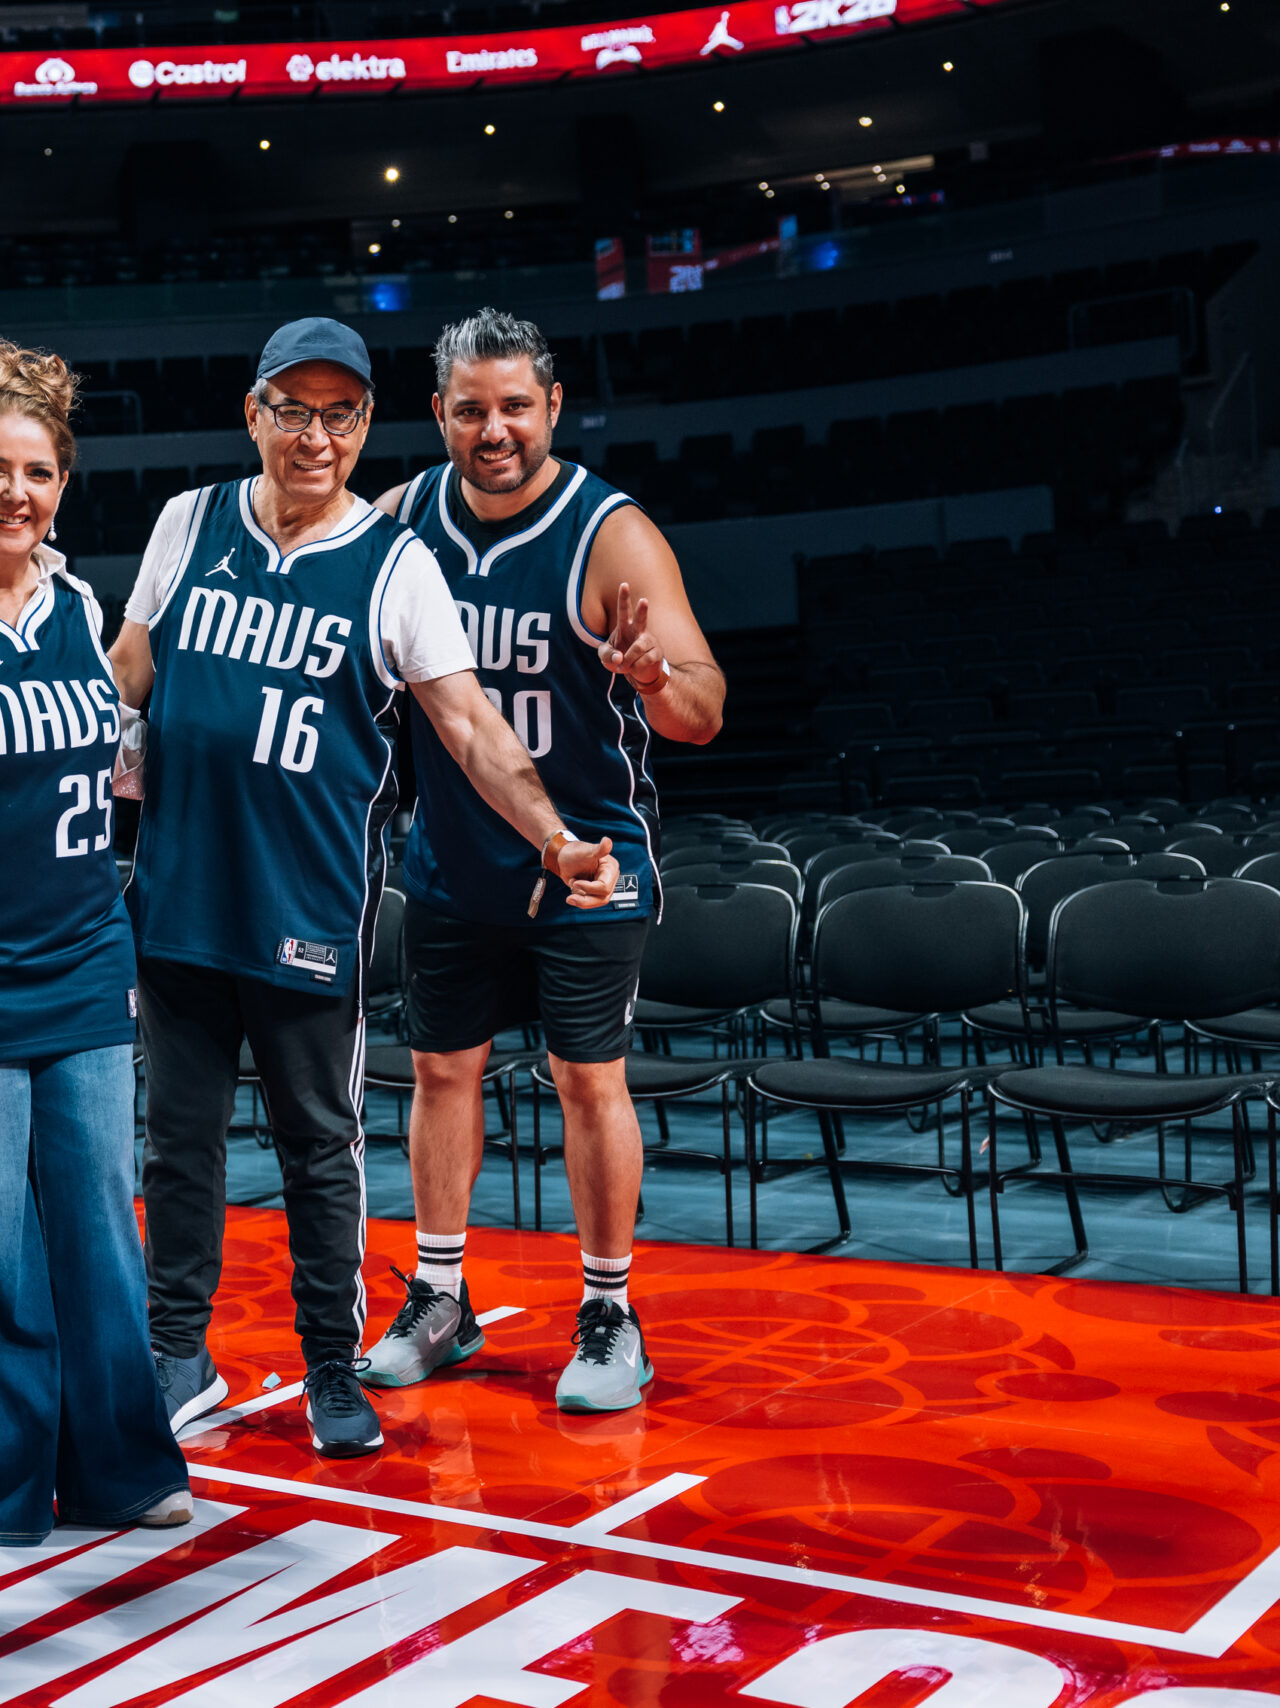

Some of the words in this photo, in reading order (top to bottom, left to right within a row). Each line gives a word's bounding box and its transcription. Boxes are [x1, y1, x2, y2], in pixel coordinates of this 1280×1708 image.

[154, 59, 247, 85] Castrol
[315, 53, 406, 81] elektra
[178, 586, 352, 678] MAVS
[252, 686, 324, 774] 16
[55, 768, 113, 858] 25
